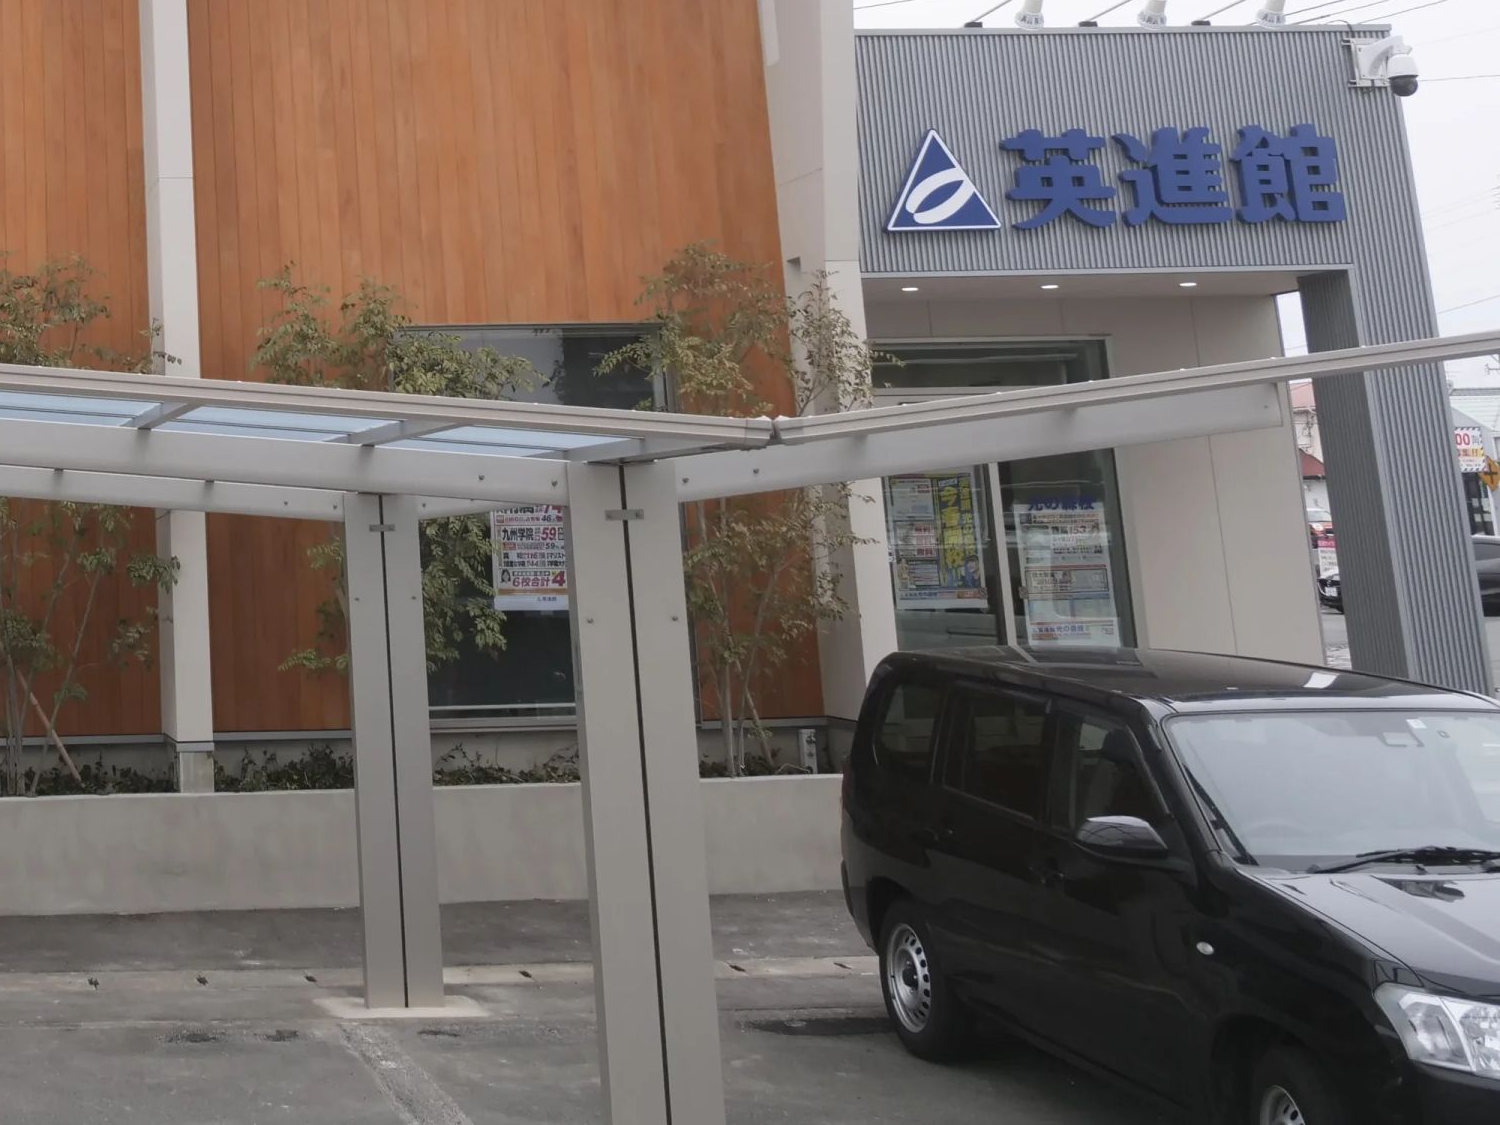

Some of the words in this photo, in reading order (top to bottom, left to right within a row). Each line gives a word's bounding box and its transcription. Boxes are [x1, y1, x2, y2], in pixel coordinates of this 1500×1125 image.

[998, 123, 1347, 230] 英進館
[502, 527, 534, 541] 九州学院
[513, 577, 550, 587] 6校合計
